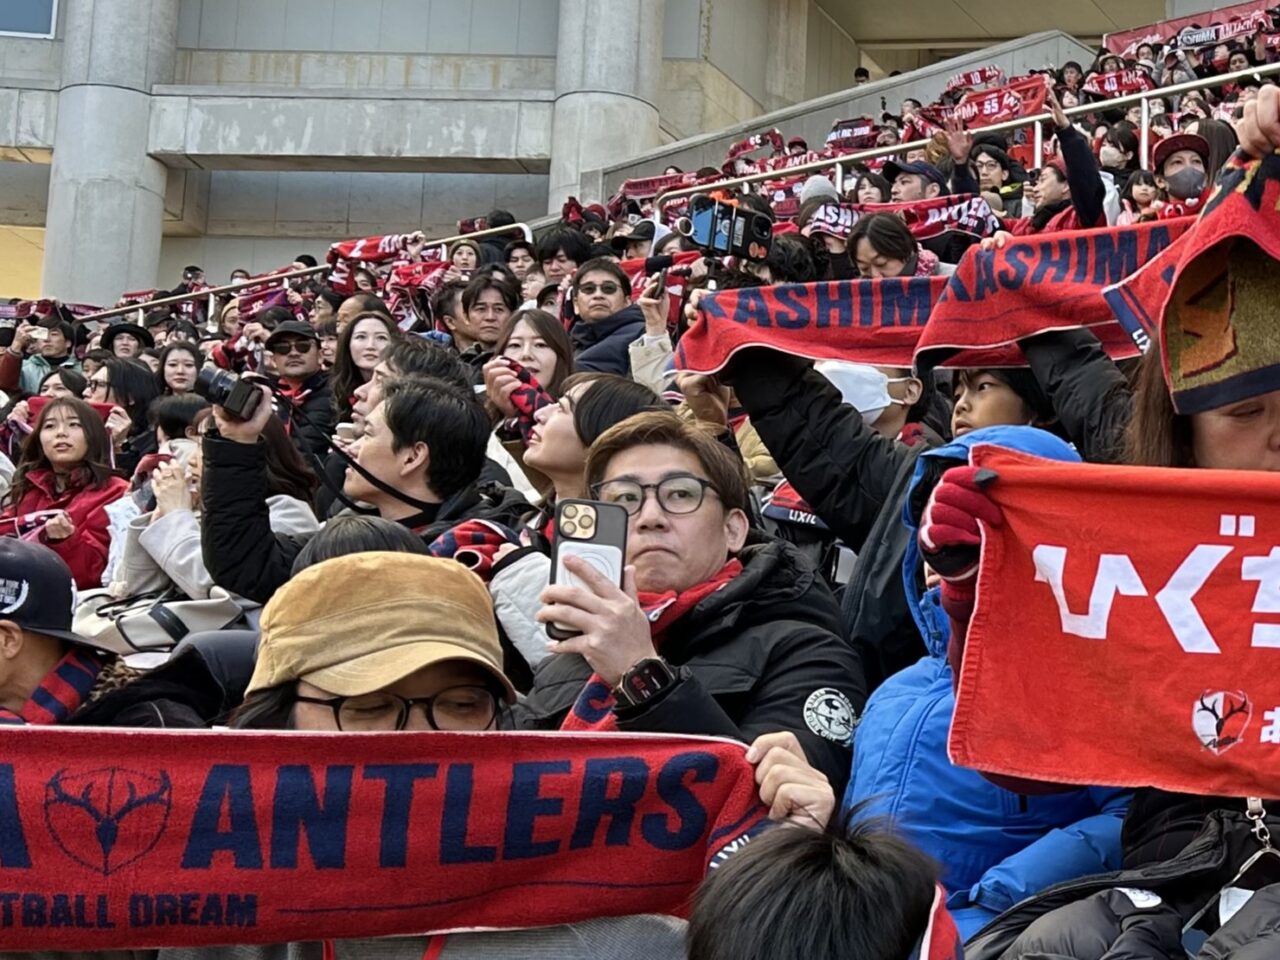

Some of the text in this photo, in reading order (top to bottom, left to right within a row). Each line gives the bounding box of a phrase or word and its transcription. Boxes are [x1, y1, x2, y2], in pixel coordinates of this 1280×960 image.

[983, 98, 999, 115] 55
[788, 509, 817, 525] LIXIL
[180, 751, 720, 870] ANTLERS
[128, 893, 258, 929] DREAM
